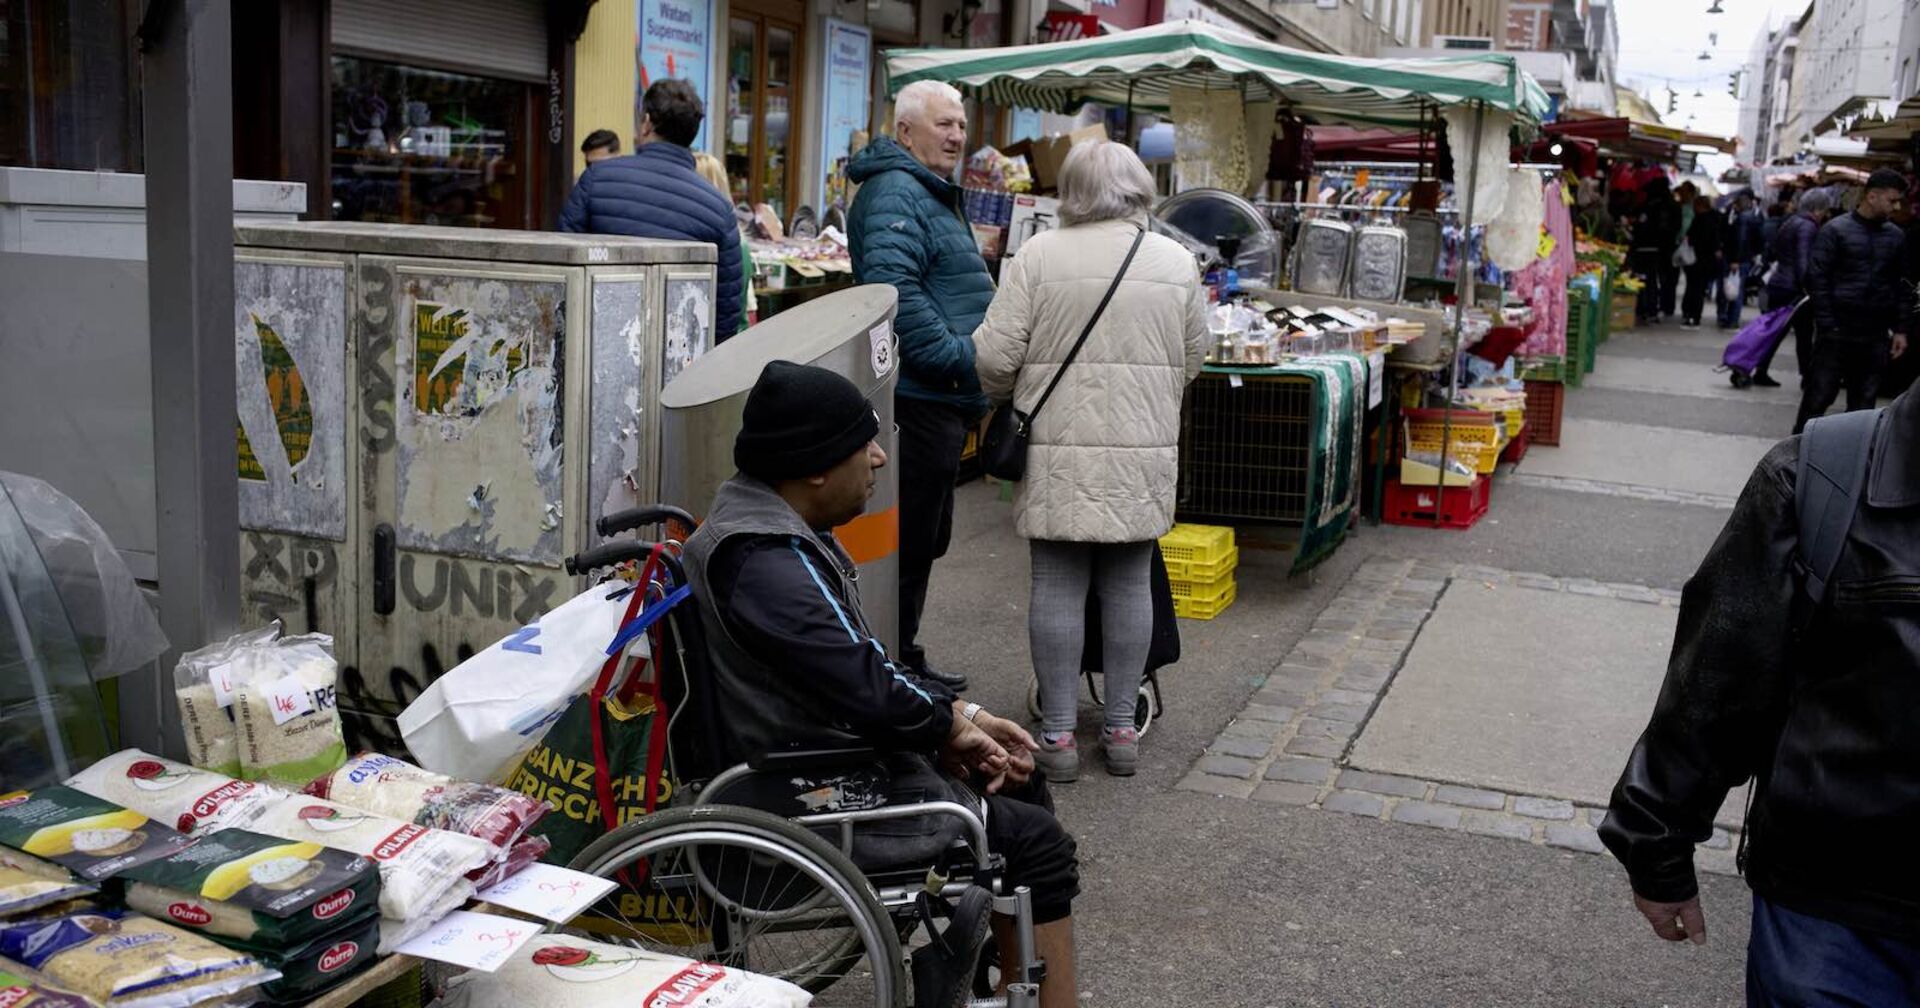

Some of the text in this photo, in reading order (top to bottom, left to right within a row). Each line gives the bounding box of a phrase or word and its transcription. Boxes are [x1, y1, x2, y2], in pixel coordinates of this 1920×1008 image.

[659, 2, 692, 25] Watani
[647, 17, 703, 47] Supermarkt
[400, 553, 557, 626] UNIX
[527, 743, 596, 792] GANZ
[172, 905, 208, 923] Durra
[318, 893, 351, 916] Durra
[321, 946, 354, 970] Durra
